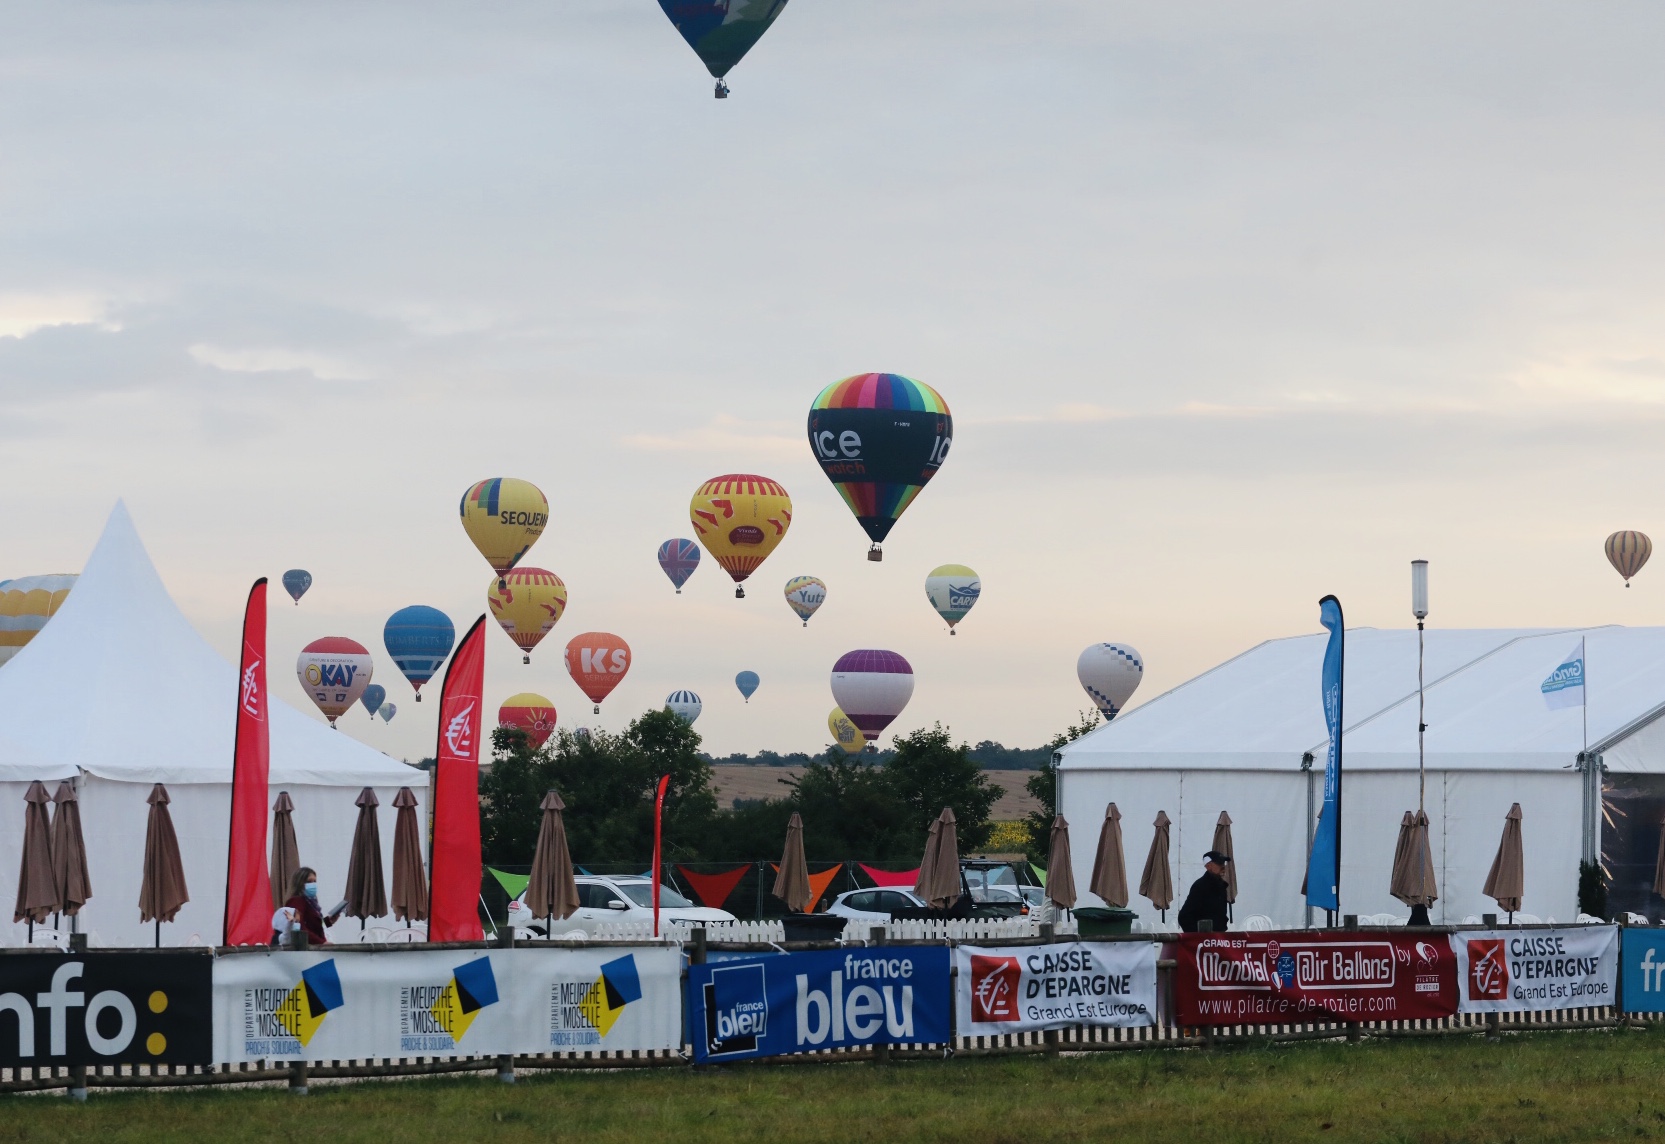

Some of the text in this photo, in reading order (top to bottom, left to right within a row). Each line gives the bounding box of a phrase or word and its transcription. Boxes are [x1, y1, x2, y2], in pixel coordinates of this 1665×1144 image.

[580, 647, 627, 674] KS
[305, 663, 358, 688] OKAY
[1203, 938, 1247, 948] GRAND EST
[1510, 936, 1566, 958] CAISSE
[845, 953, 913, 980] france
[1026, 950, 1092, 975] CAISSE
[1203, 952, 1269, 982] Mondial
[1333, 951, 1390, 981] Ballons
[1395, 945, 1411, 967] by
[1511, 957, 1599, 980] D'EPARGNE
[410, 986, 453, 1009] MEURTHE
[560, 982, 601, 1005] MEURTHE
[1026, 974, 1131, 999] D'EPARGNE
[1513, 981, 1609, 1000] Grand Est Europe
[255, 988, 301, 1012] MEURTHE
[736, 1001, 764, 1012] france
[796, 970, 915, 1046] bleu
[1027, 1001, 1147, 1021] Grand Est Europe
[1198, 994, 1397, 1018] www.pilatre-de-rozier.com
[259, 1013, 302, 1037] MOSELLE
[413, 1010, 454, 1034] MOSELLE
[563, 1006, 601, 1029] MOSELLE
[717, 1010, 765, 1038] bleu
